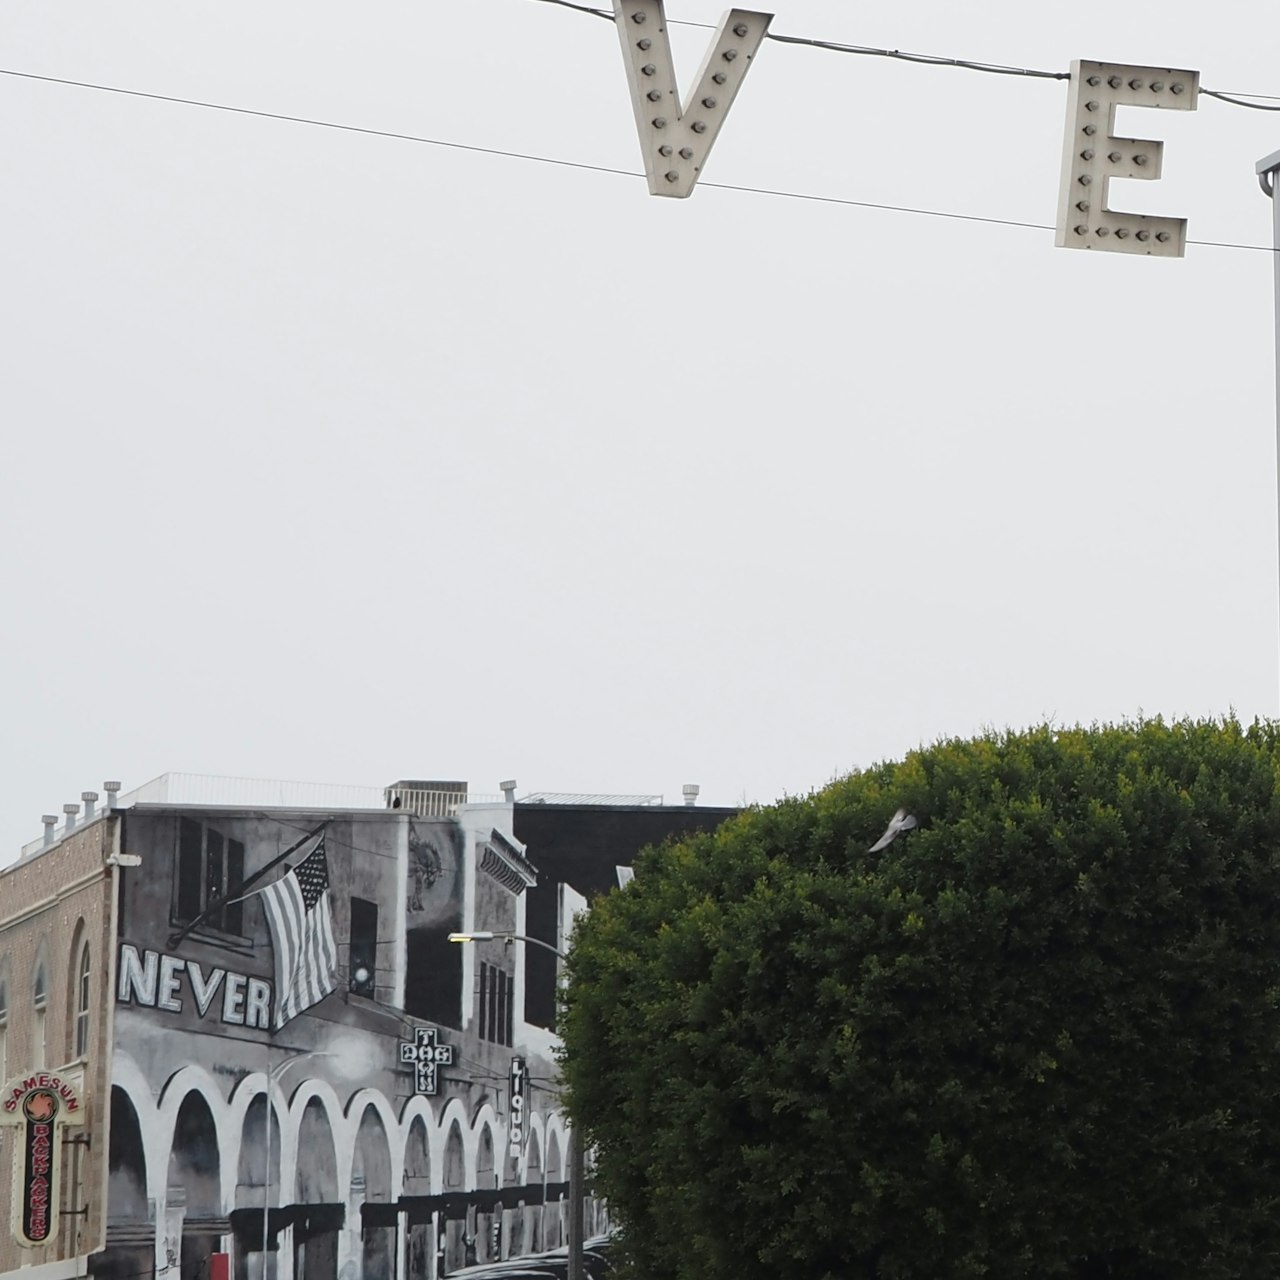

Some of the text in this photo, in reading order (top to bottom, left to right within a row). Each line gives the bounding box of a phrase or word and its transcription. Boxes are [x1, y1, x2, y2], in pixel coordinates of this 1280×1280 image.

[118, 943, 272, 1030] NEVER
[4, 1075, 79, 1114] SAMESUN
[30, 1124, 50, 1240] BACKPACKERS
